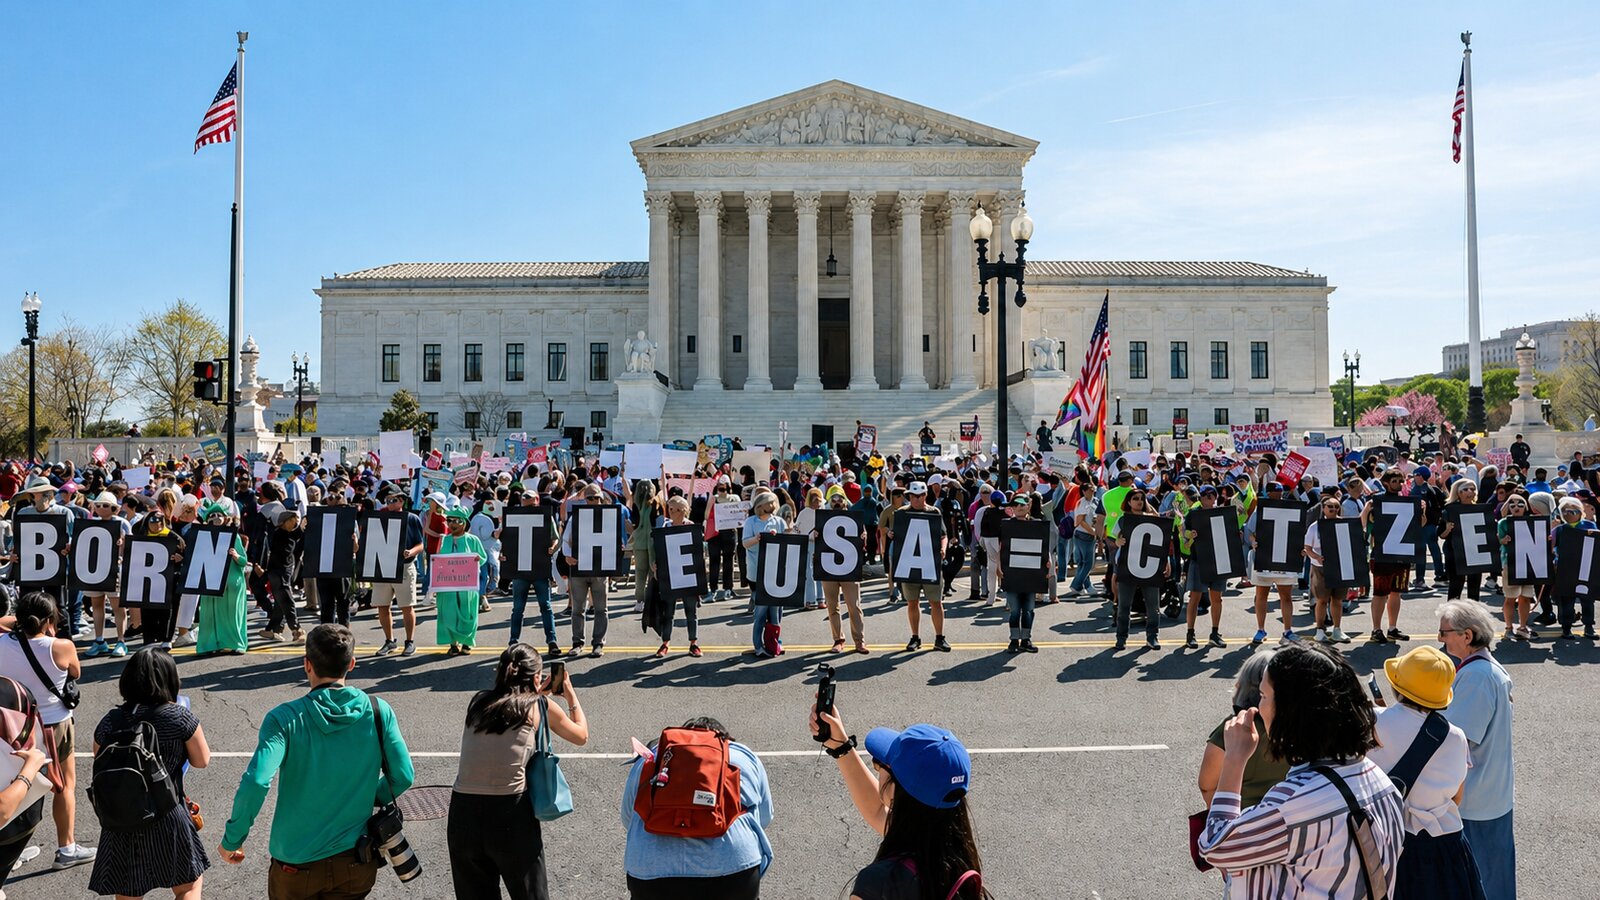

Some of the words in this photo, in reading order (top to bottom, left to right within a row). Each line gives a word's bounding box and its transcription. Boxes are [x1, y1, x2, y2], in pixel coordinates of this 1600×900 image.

[20, 522, 233, 603] BORN
[319, 513, 402, 579] IN
[505, 508, 698, 591] THE
[763, 516, 937, 598] USA
[1127, 502, 1595, 595] CITIZEN!
